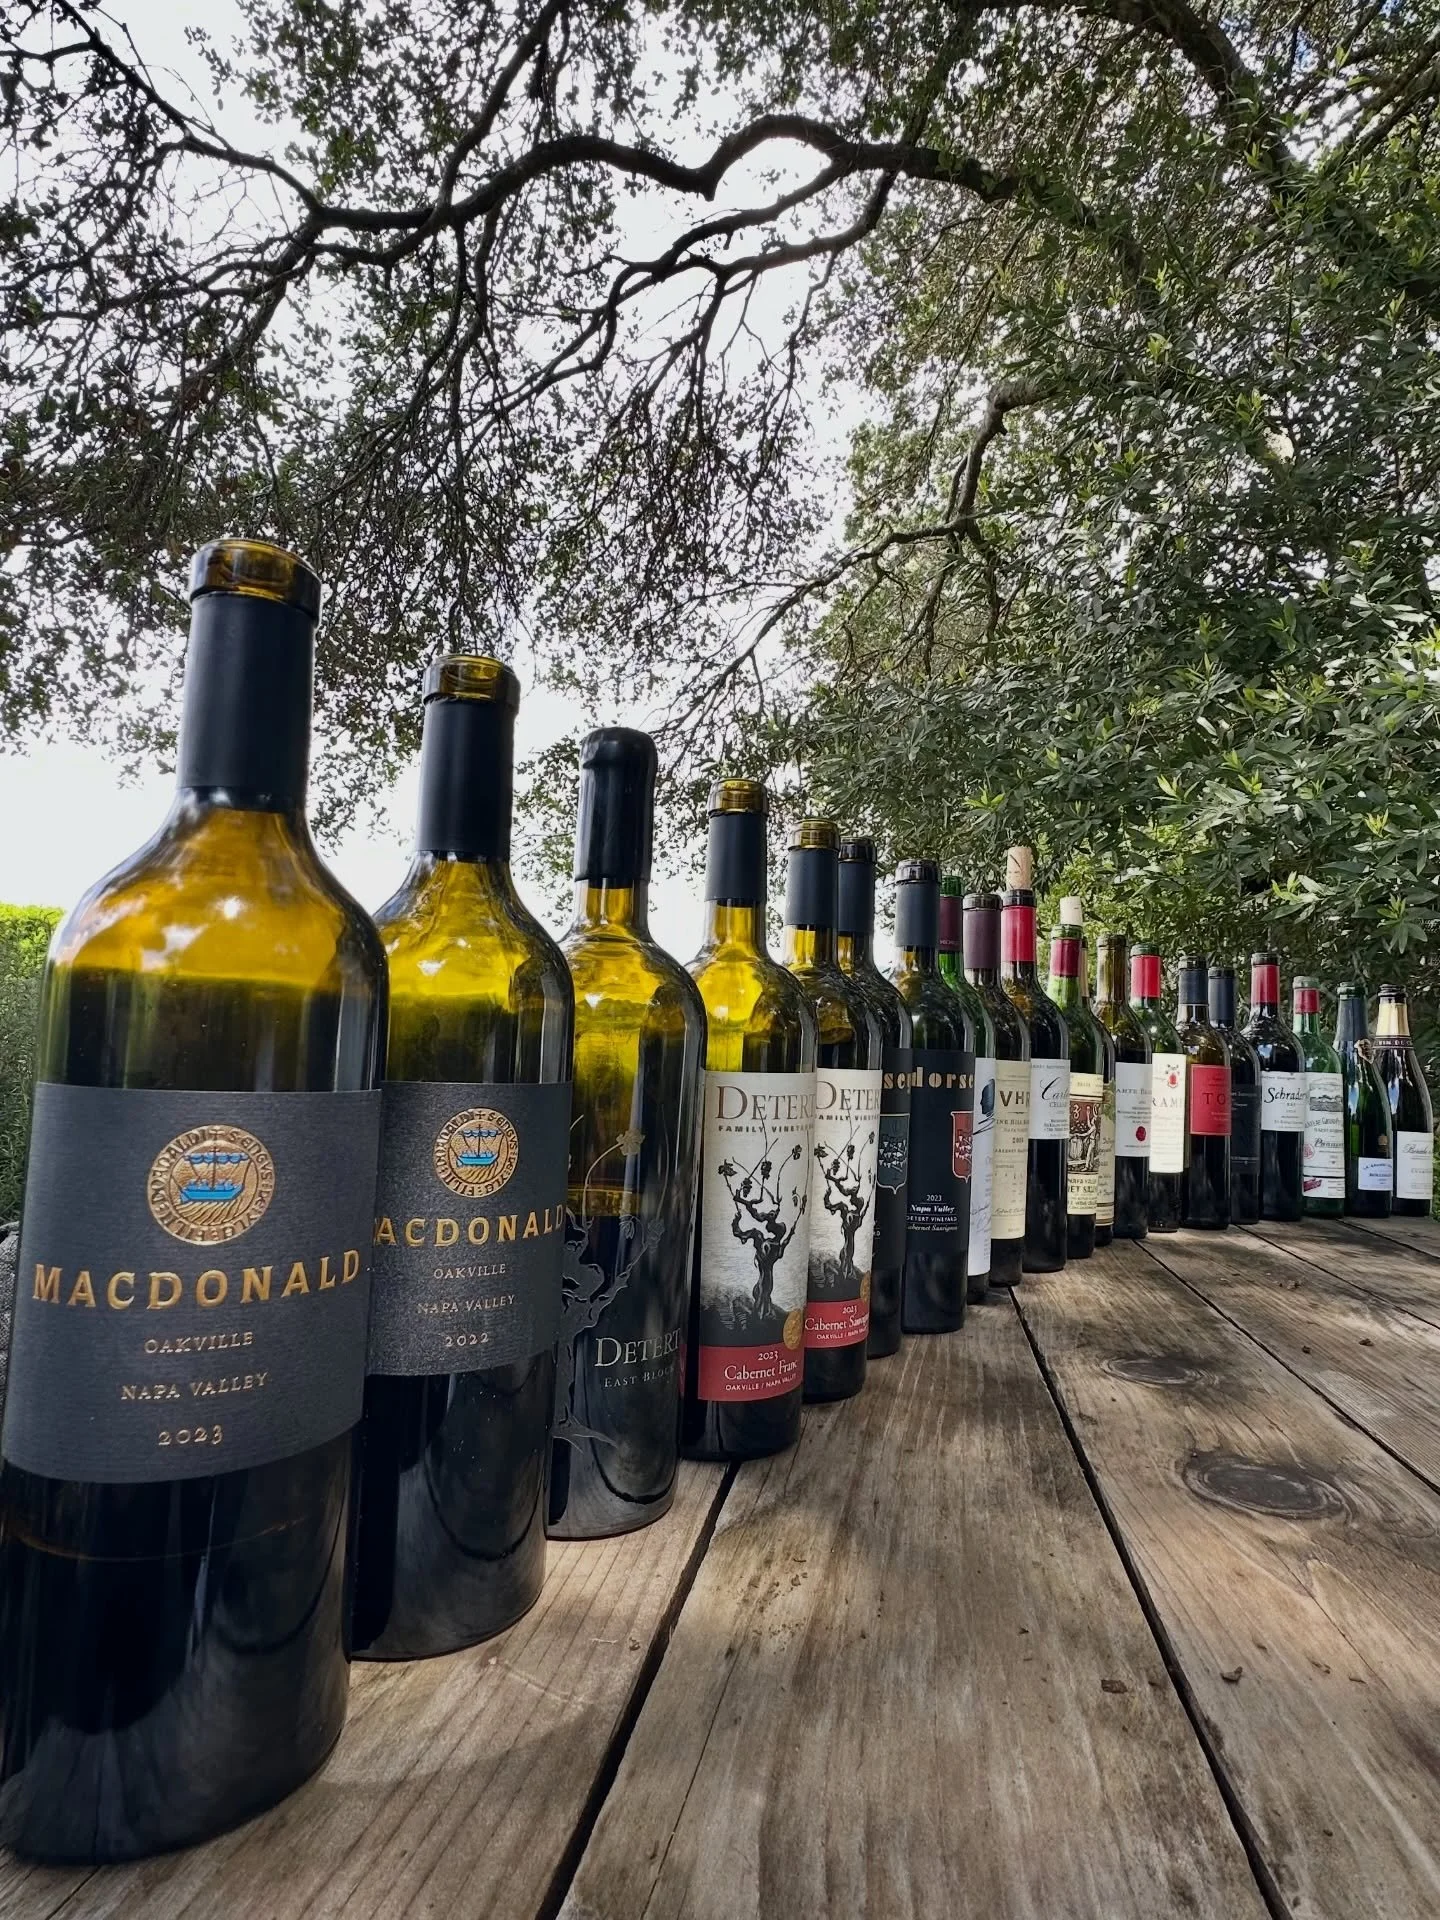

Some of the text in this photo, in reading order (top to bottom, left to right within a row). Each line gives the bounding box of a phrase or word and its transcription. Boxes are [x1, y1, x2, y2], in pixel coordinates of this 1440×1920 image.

[715, 1085, 816, 1120] DETERT
[815, 1113, 850, 1121] AMILY
[719, 1125, 765, 1133] FAMILY
[926, 1194, 942, 1202] 2023
[911, 1204, 955, 1214] Napa Valley
[374, 1204, 565, 1248] ACDONALD
[32, 1249, 362, 1311] MACDONALD
[433, 1264, 506, 1280] OAKVILLE
[417, 1294, 516, 1316] NAPA VALLEY
[804, 1317, 847, 1331] Cabernet
[144, 1332, 255, 1355] OAKVILLE
[445, 1332, 490, 1348] 2022
[594, 1328, 681, 1367] DETERT
[758, 1350, 779, 1361] 2023
[724, 1360, 798, 1381] Cabernet Franc
[121, 1372, 269, 1402] NAPA VALLEY
[604, 1376, 638, 1388] EAST
[725, 1383, 760, 1391] OAKVILLE
[766, 1380, 782, 1388] NAPA
[158, 1424, 225, 1447] 2023
